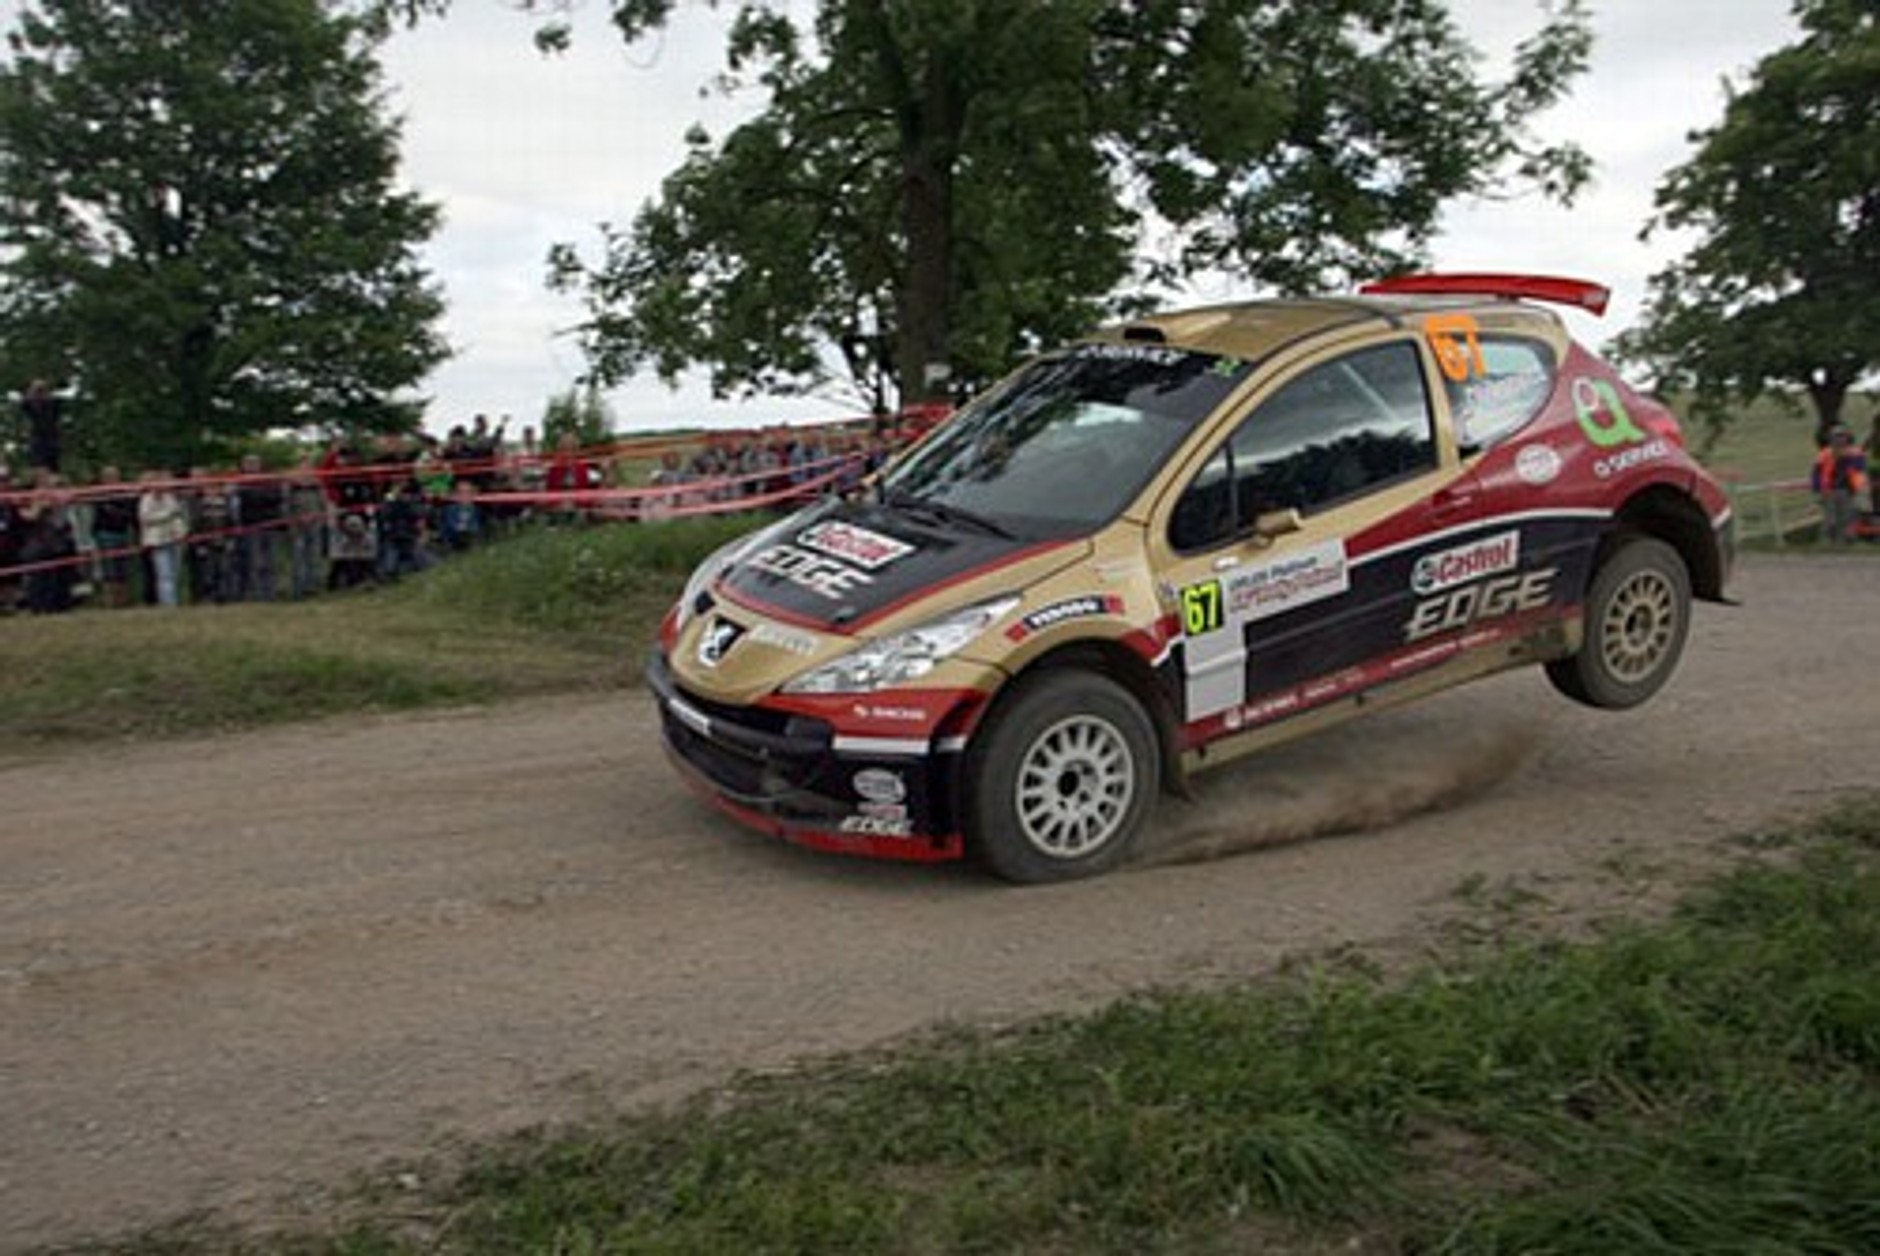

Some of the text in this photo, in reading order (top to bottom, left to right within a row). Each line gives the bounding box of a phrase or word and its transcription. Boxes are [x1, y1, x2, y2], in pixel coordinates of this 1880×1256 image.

[748, 545, 876, 599] EDGE
[1437, 536, 1514, 583] Castrol
[1184, 582, 1221, 634] 67
[1402, 568, 1562, 643] EDGE
